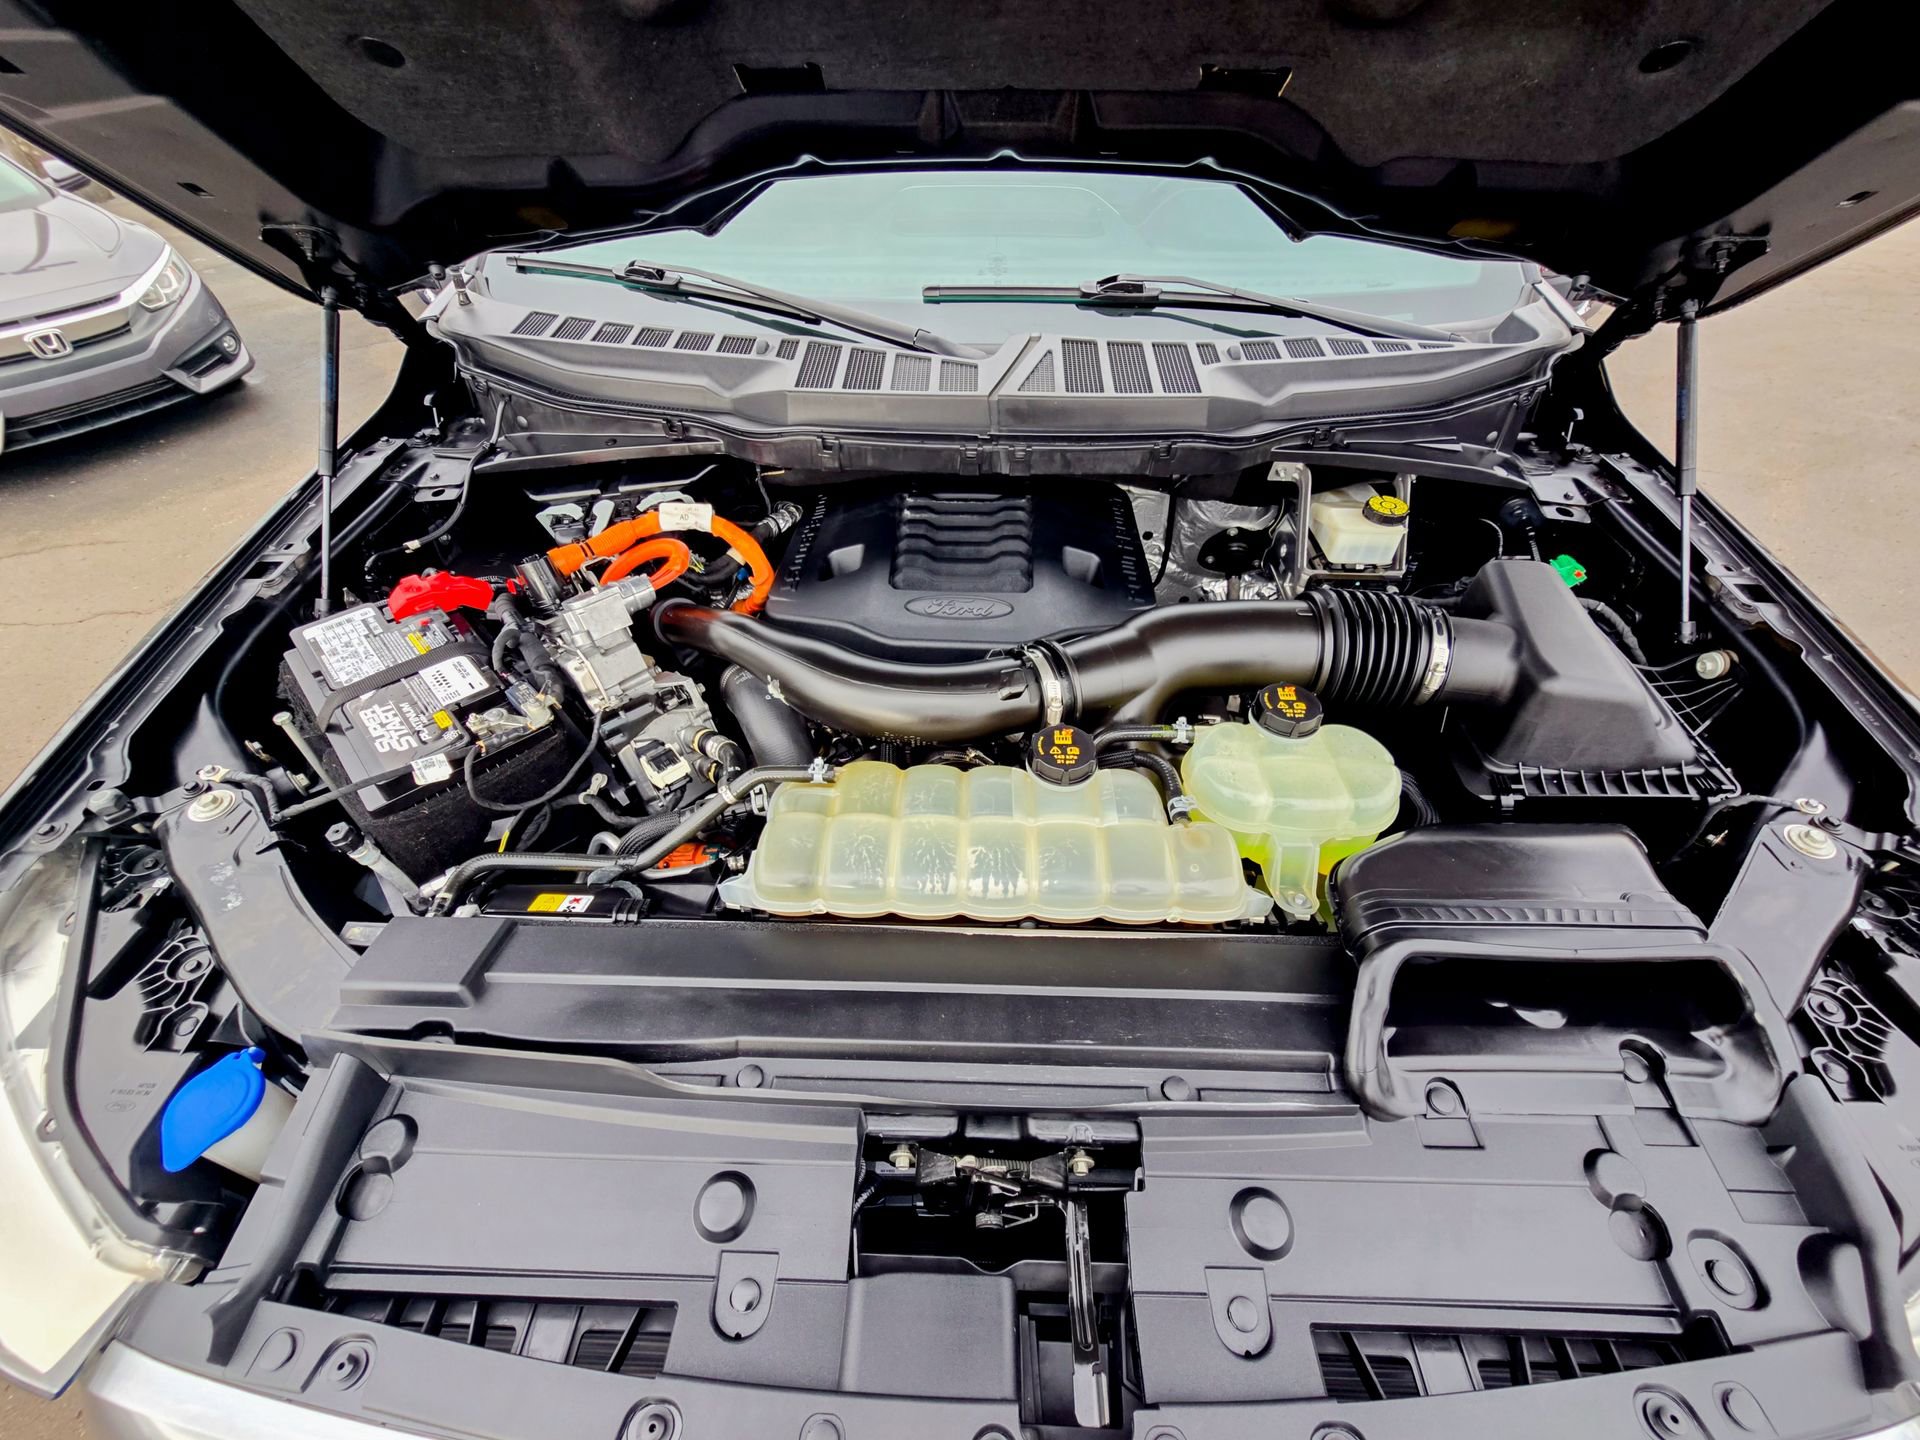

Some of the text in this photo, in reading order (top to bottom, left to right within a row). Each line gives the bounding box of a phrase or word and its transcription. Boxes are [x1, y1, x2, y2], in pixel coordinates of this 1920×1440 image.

[679, 513, 690, 521] AD
[924, 598, 995, 618] Ford
[359, 708, 390, 753] SUPER
[373, 704, 418, 752] START
[399, 702, 432, 742] PLATINUM
